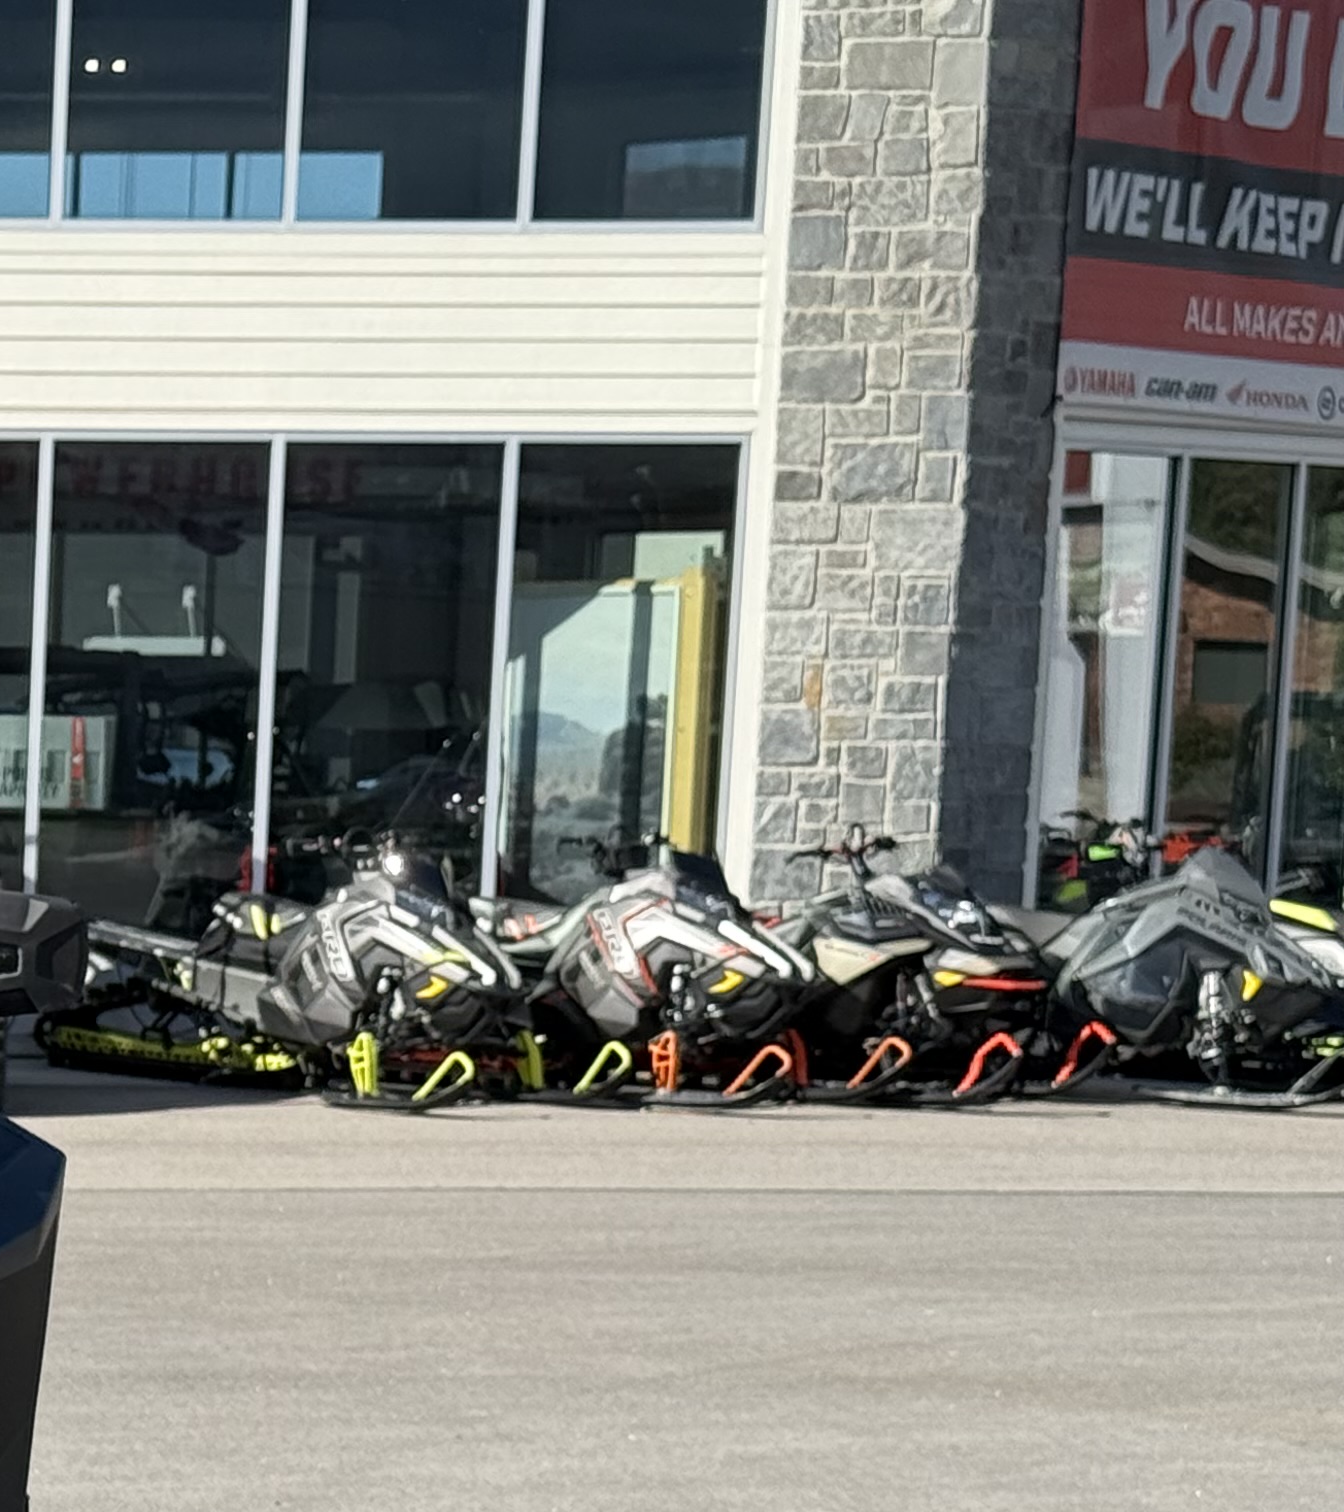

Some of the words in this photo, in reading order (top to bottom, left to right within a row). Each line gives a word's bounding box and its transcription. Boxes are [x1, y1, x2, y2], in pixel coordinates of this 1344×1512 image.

[1143, 0, 1310, 131] YOU
[1084, 166, 1208, 246] WE'LL
[1215, 186, 1330, 260] KEEP
[1183, 295, 1229, 337] ALL
[1232, 302, 1318, 346] MAKES
[1079, 366, 1137, 397] YAMAHA
[1244, 389, 1311, 413] HONDA
